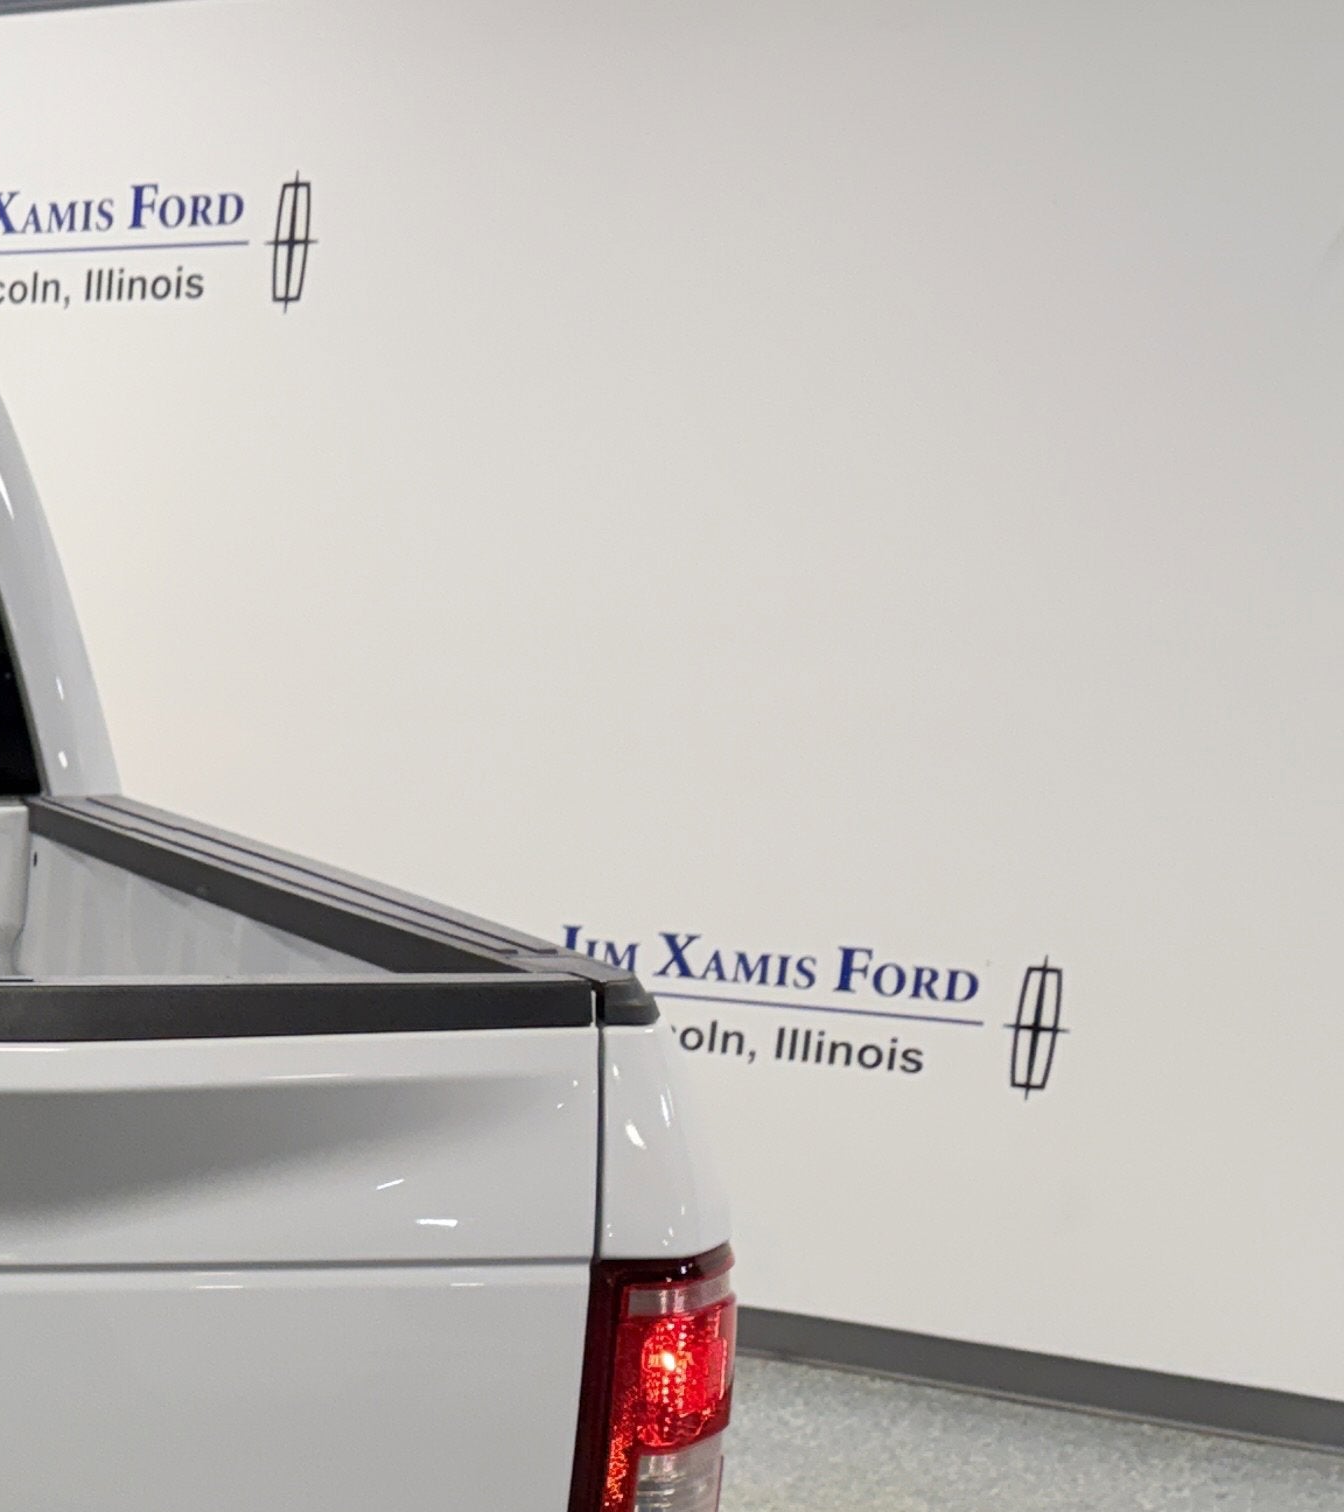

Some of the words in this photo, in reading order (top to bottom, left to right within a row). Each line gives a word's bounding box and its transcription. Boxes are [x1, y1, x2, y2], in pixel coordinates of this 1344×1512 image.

[128, 183, 245, 230] FORD
[84, 265, 205, 303] Illinois
[652, 931, 819, 991] XAMIS
[833, 945, 980, 1003] FORD
[774, 1026, 925, 1074] Illinois
